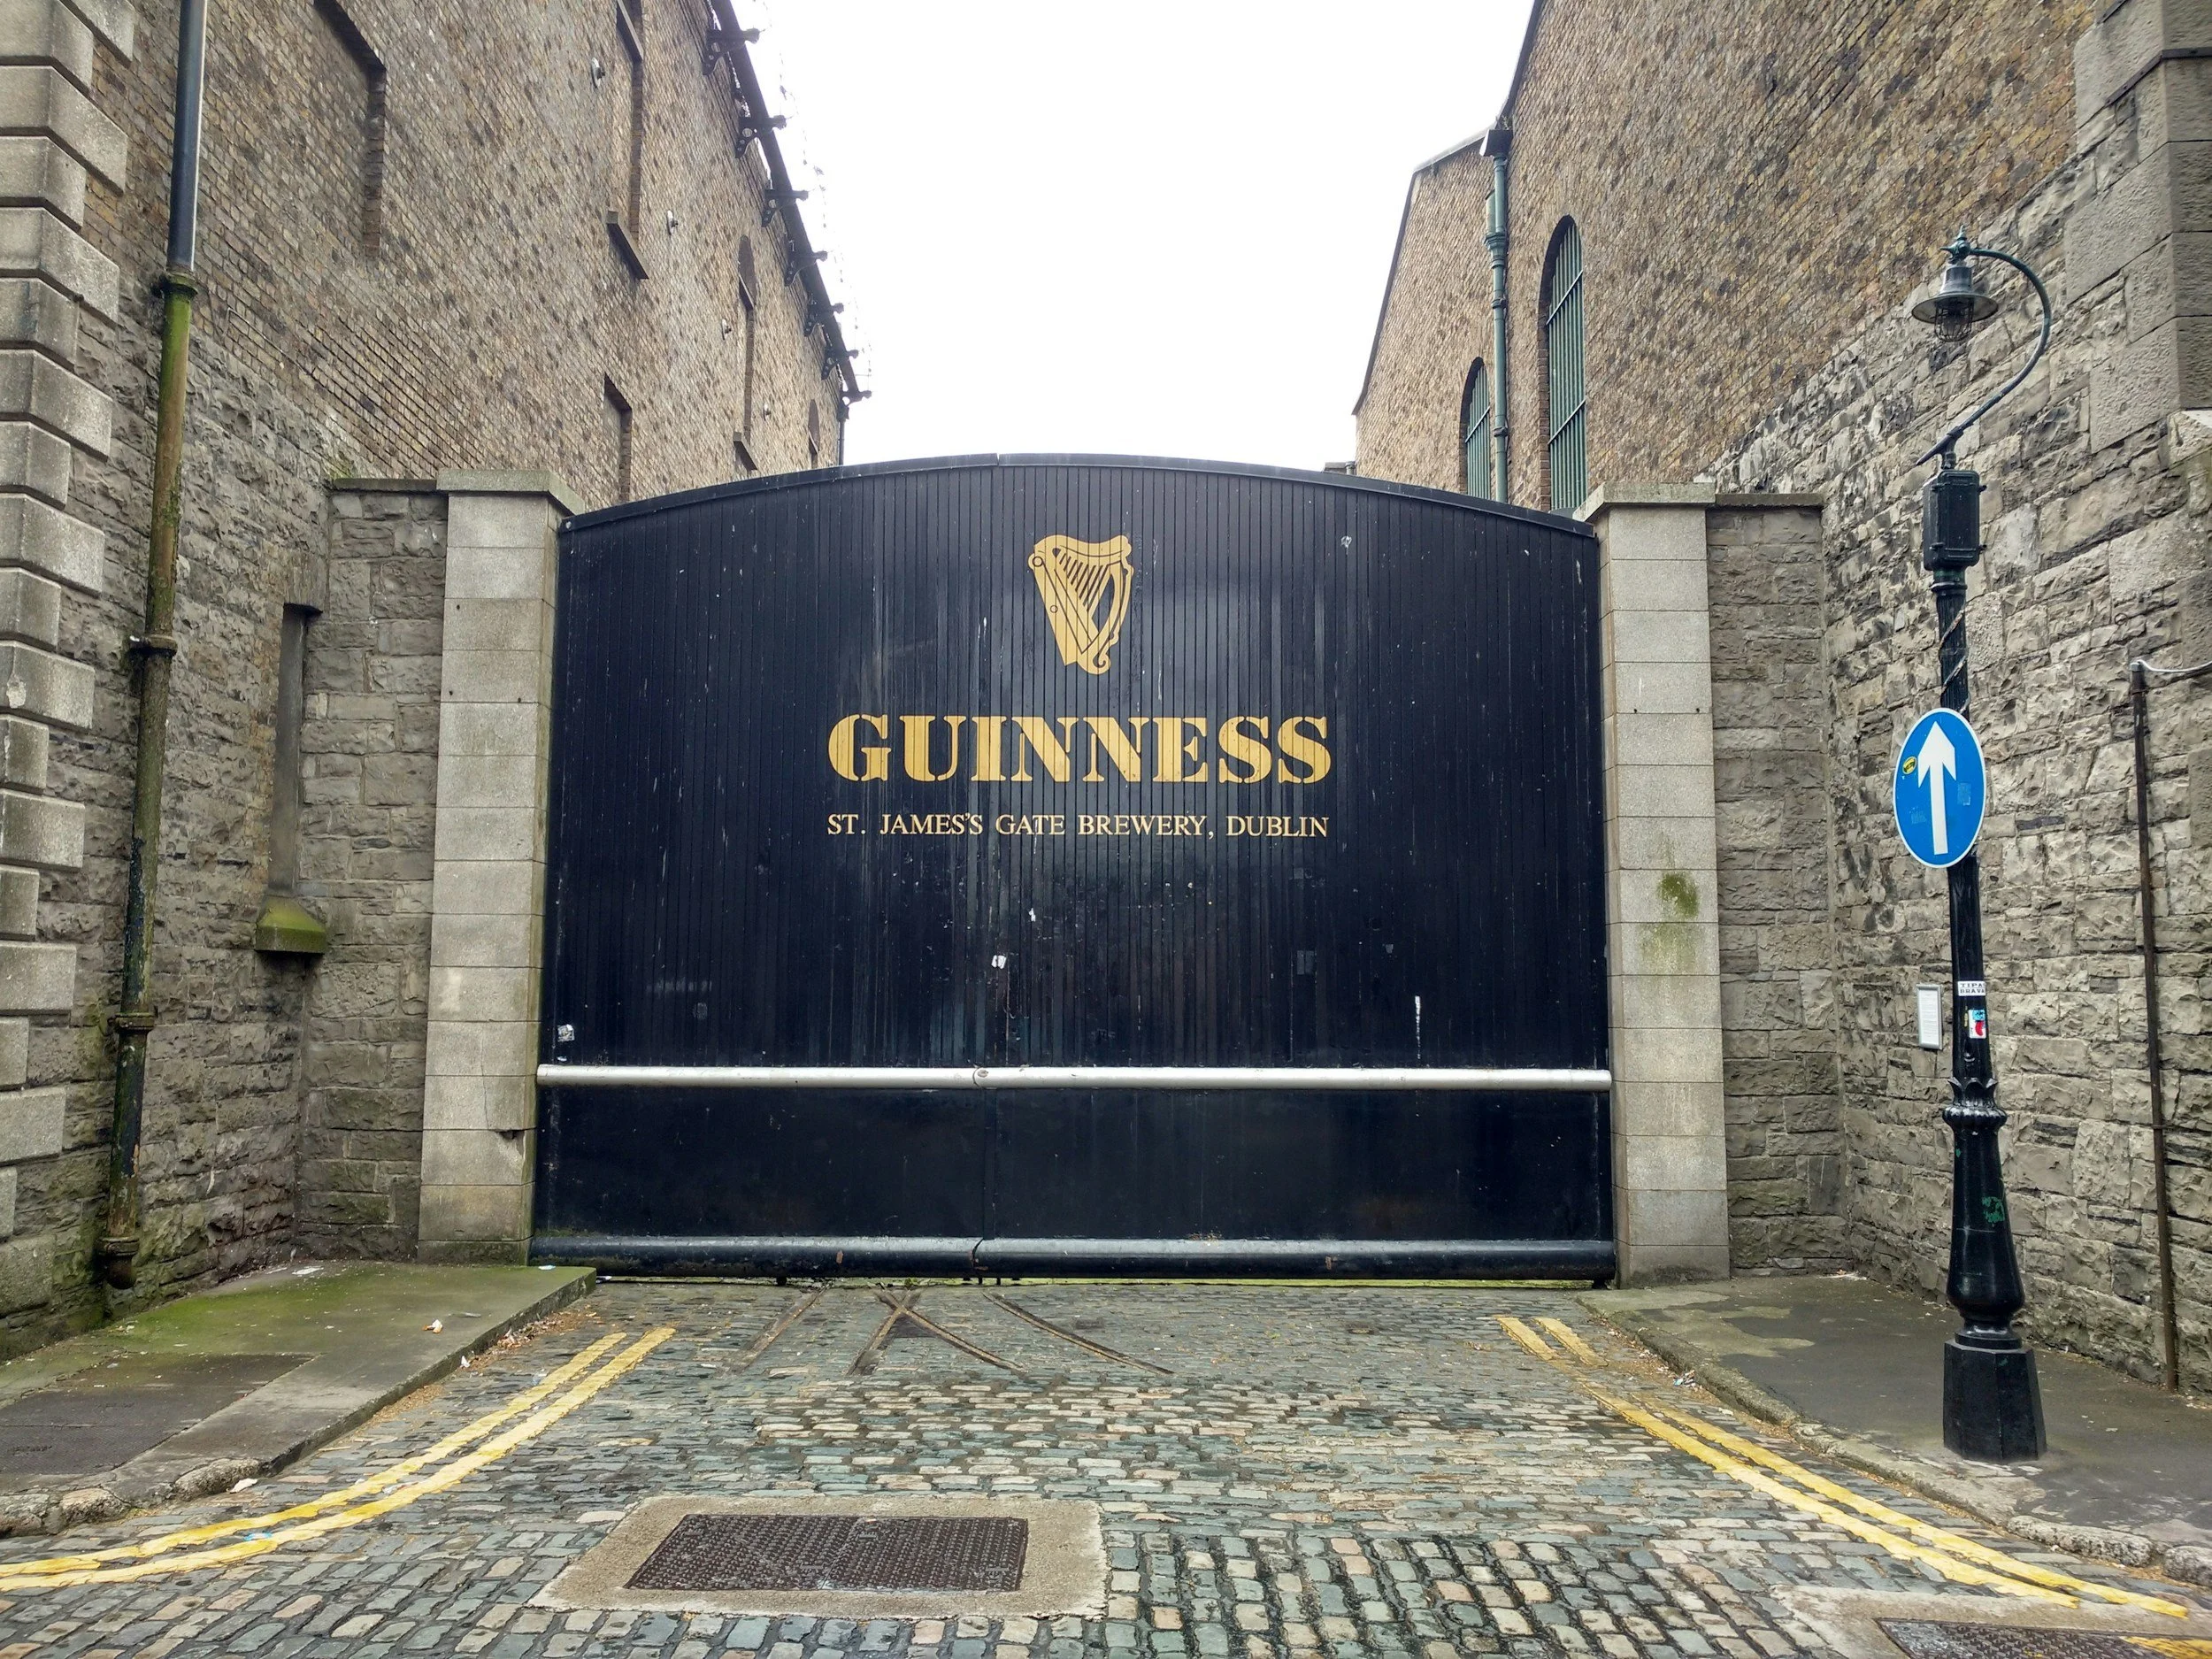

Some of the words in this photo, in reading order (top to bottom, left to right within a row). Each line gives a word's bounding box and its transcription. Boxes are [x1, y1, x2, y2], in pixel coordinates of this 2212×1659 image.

[828, 714, 1332, 783] GUINNESS
[828, 812, 865, 835] ST.
[879, 813, 983, 835] JAMES'S
[995, 814, 1065, 835] GATE
[1077, 814, 1214, 840] BREWERY,
[1227, 815, 1330, 838] DUBLIN
